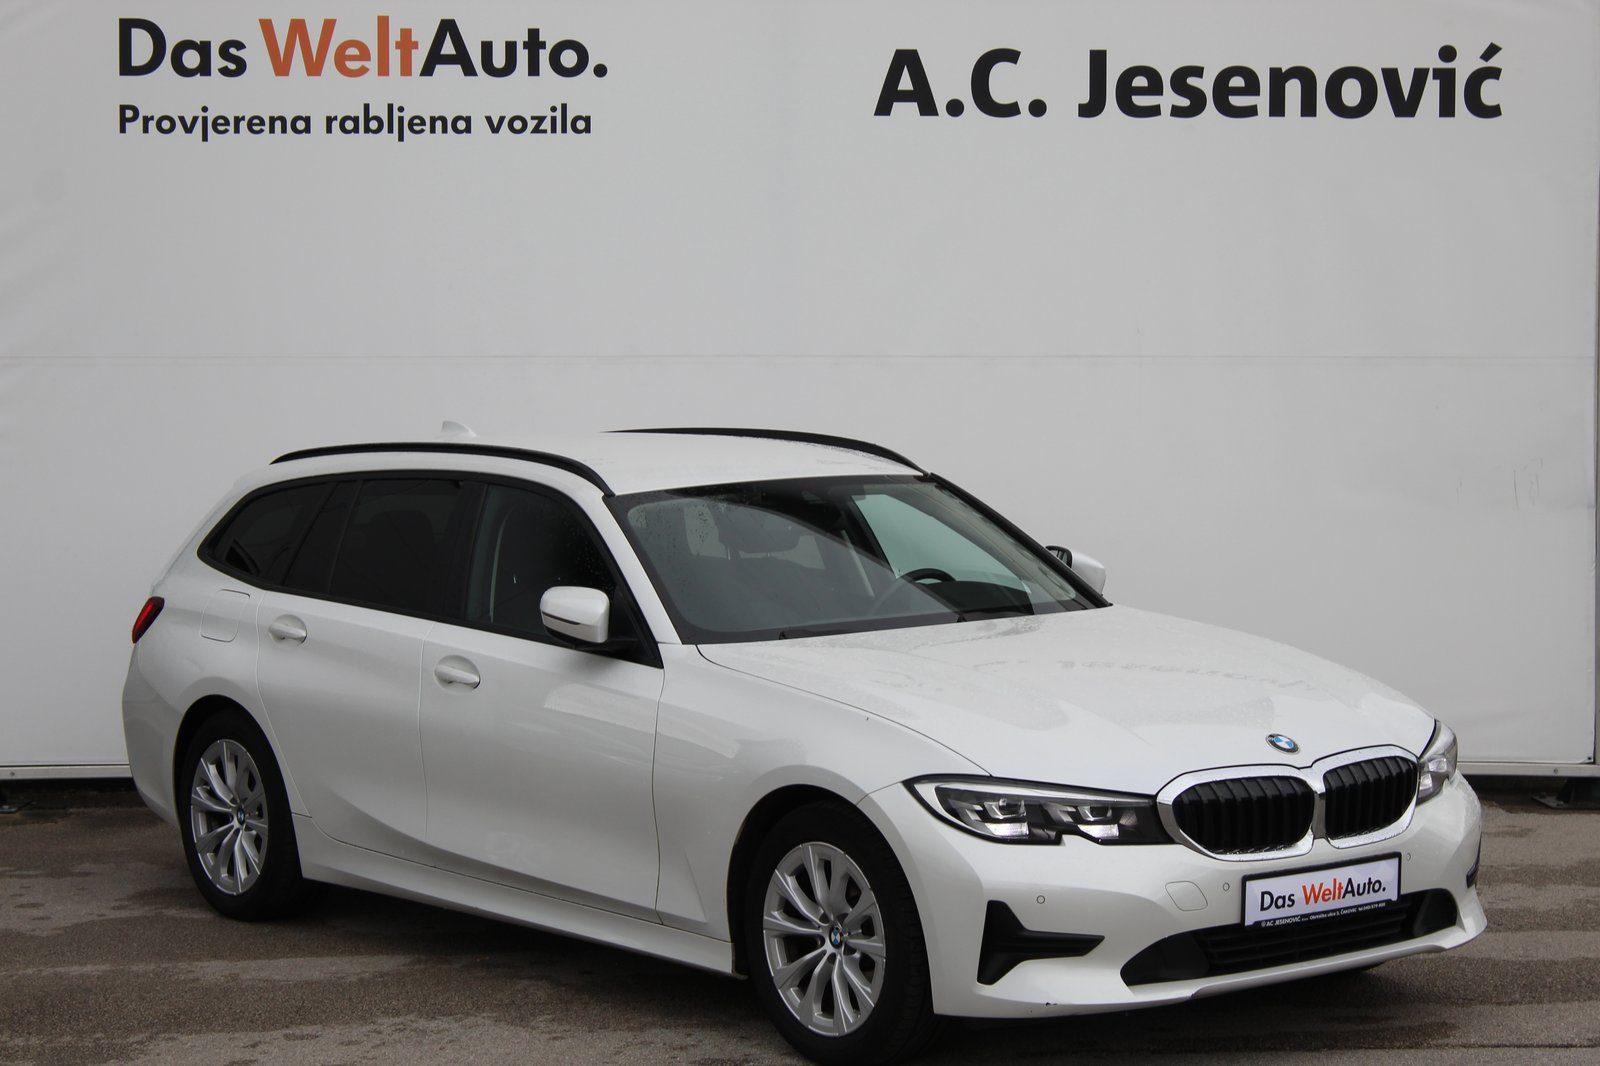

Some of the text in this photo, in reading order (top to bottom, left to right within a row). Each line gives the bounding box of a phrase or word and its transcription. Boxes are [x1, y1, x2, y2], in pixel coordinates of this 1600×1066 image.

[118, 15, 608, 79] Das WeltAuto.
[873, 41, 1503, 120] A.C. Jesenović
[118, 102, 592, 143] Provjerena rabljena vozila
[1259, 877, 1387, 912] Das WeltAuto.
